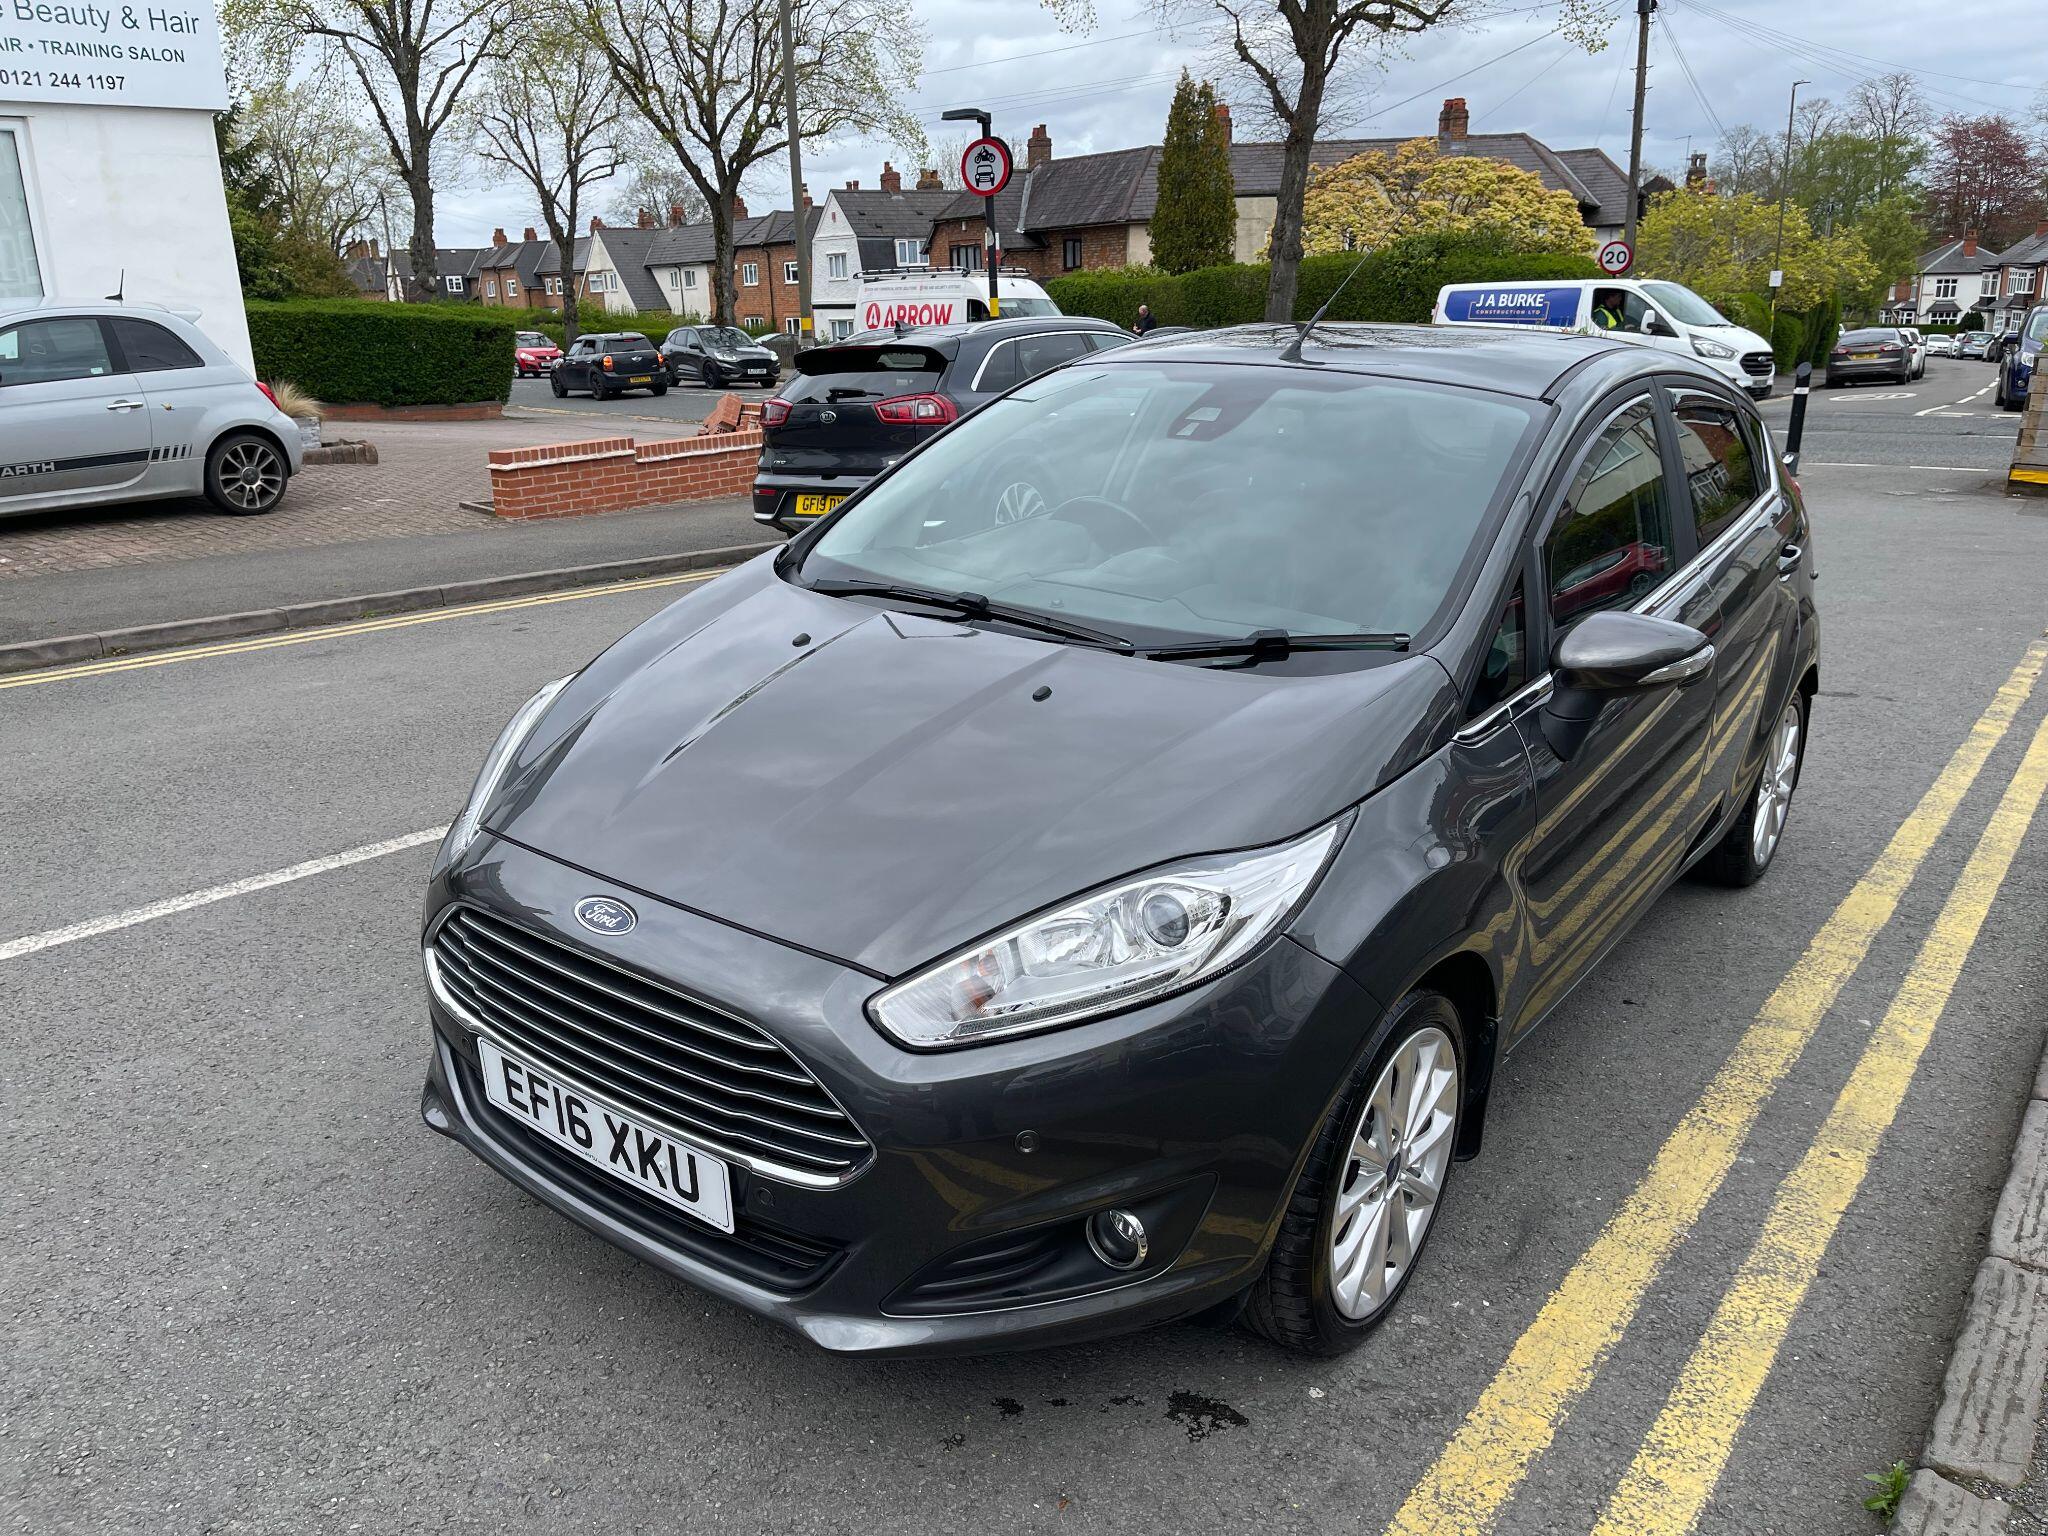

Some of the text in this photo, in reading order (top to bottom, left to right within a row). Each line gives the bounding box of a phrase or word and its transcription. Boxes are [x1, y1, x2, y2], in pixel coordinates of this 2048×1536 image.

[14, 0, 110, 33] Beauty
[121, 5, 139, 29] &
[149, 8, 200, 34] Hair
[39, 39, 123, 58] TRAINING
[128, 46, 185, 63] SALON
[0, 69, 125, 90] 0121 244 1197
[1605, 250, 1627, 264] 20
[1476, 293, 1545, 307] J A BURKE
[883, 304, 953, 328] ARROW
[1, 462, 55, 477] ARTH
[802, 497, 826, 511] GF19
[586, 904, 622, 928] Ford
[501, 1056, 700, 1203] EF16 XKU
